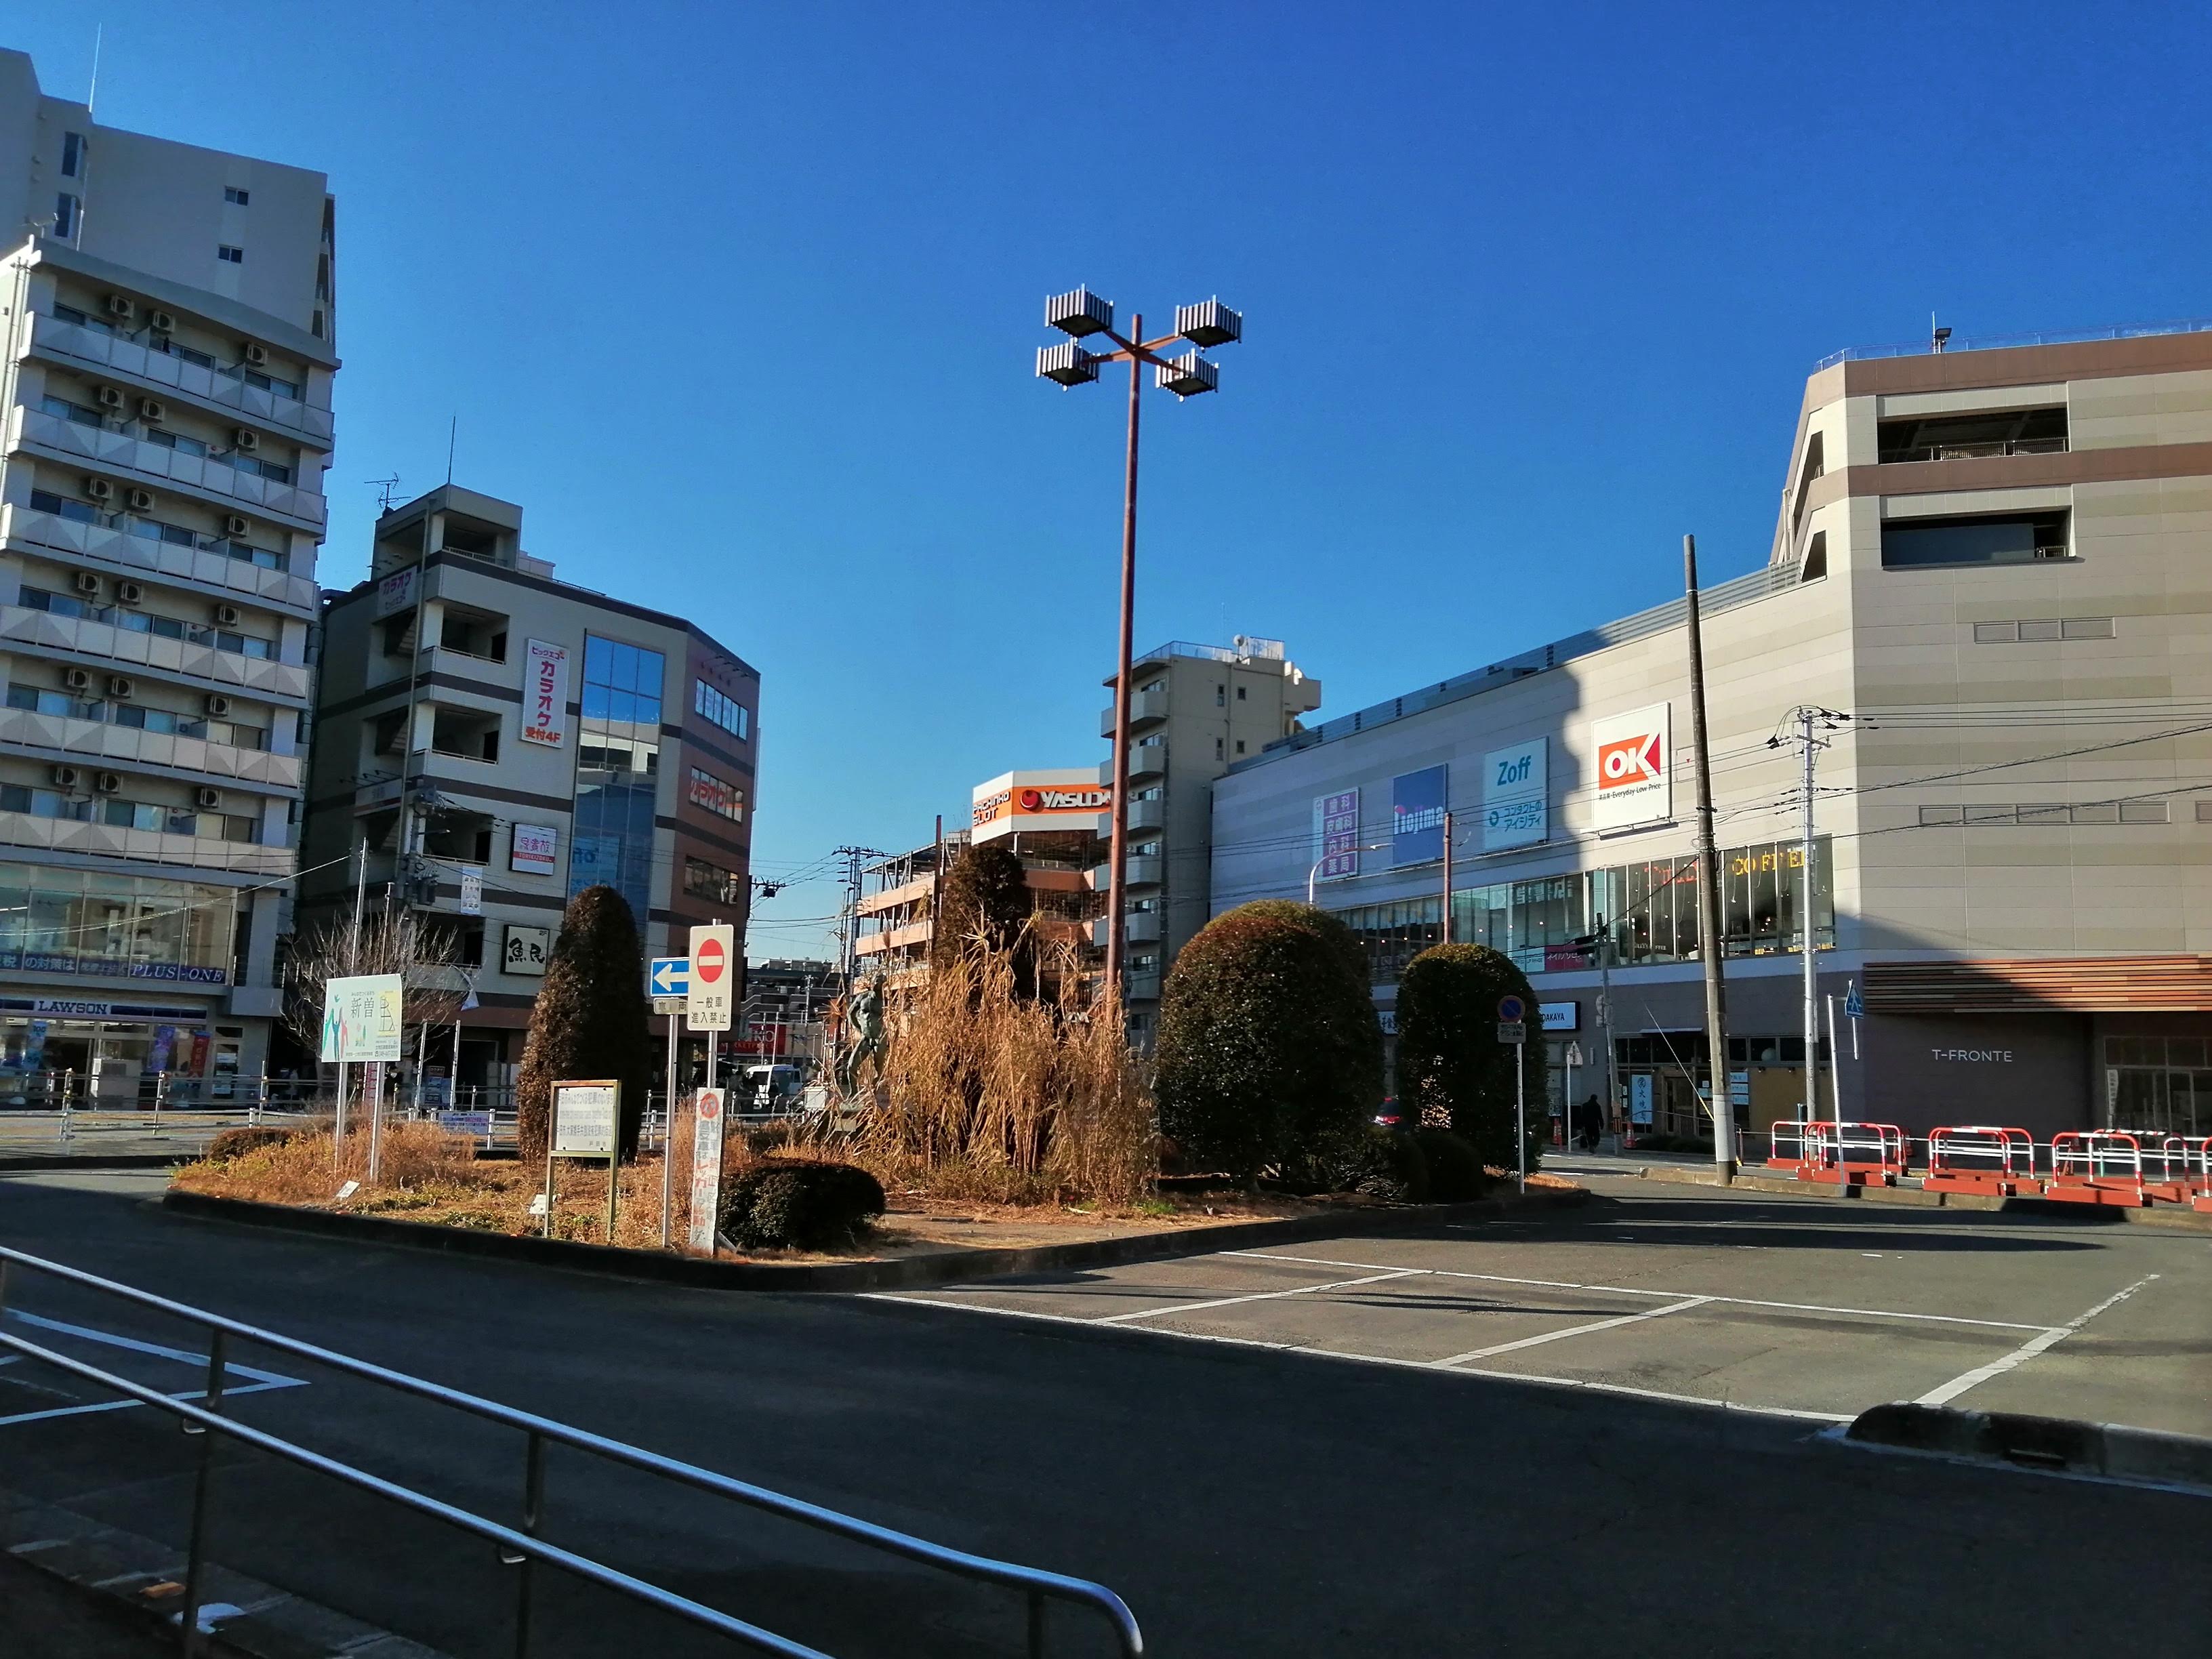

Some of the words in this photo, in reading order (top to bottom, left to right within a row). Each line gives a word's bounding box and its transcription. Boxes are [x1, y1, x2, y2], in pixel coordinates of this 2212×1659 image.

[383, 572, 412, 596] カラオケ
[537, 660, 555, 727] カラオケ
[525, 726, 561, 743] 受付4F
[1604, 733, 1658, 780] OK
[1497, 755, 1532, 786] Zoff
[691, 781, 725, 807] カラオケ
[973, 792, 1010, 814] PACHINKO
[1329, 794, 1350, 814] 歯科
[1504, 801, 1542, 817] コンタクトの
[973, 808, 998, 826] SLOT
[1327, 815, 1353, 834] 皮膚科
[1504, 815, 1542, 832] アイシティ
[1328, 835, 1349, 855] 内科
[1328, 857, 1349, 874] 薬局
[508, 937, 546, 964] 魚民
[132, 964, 224, 982] PLUS-ONE
[38, 1000, 108, 1015] LAWSON
[351, 997, 375, 1019] 新曽
[697, 996, 722, 1008] 一般車
[691, 1011, 726, 1023] 進入禁止
[1542, 1012, 1565, 1021] DAKAYA
[1931, 1049, 2013, 1063] T-FRONTE
